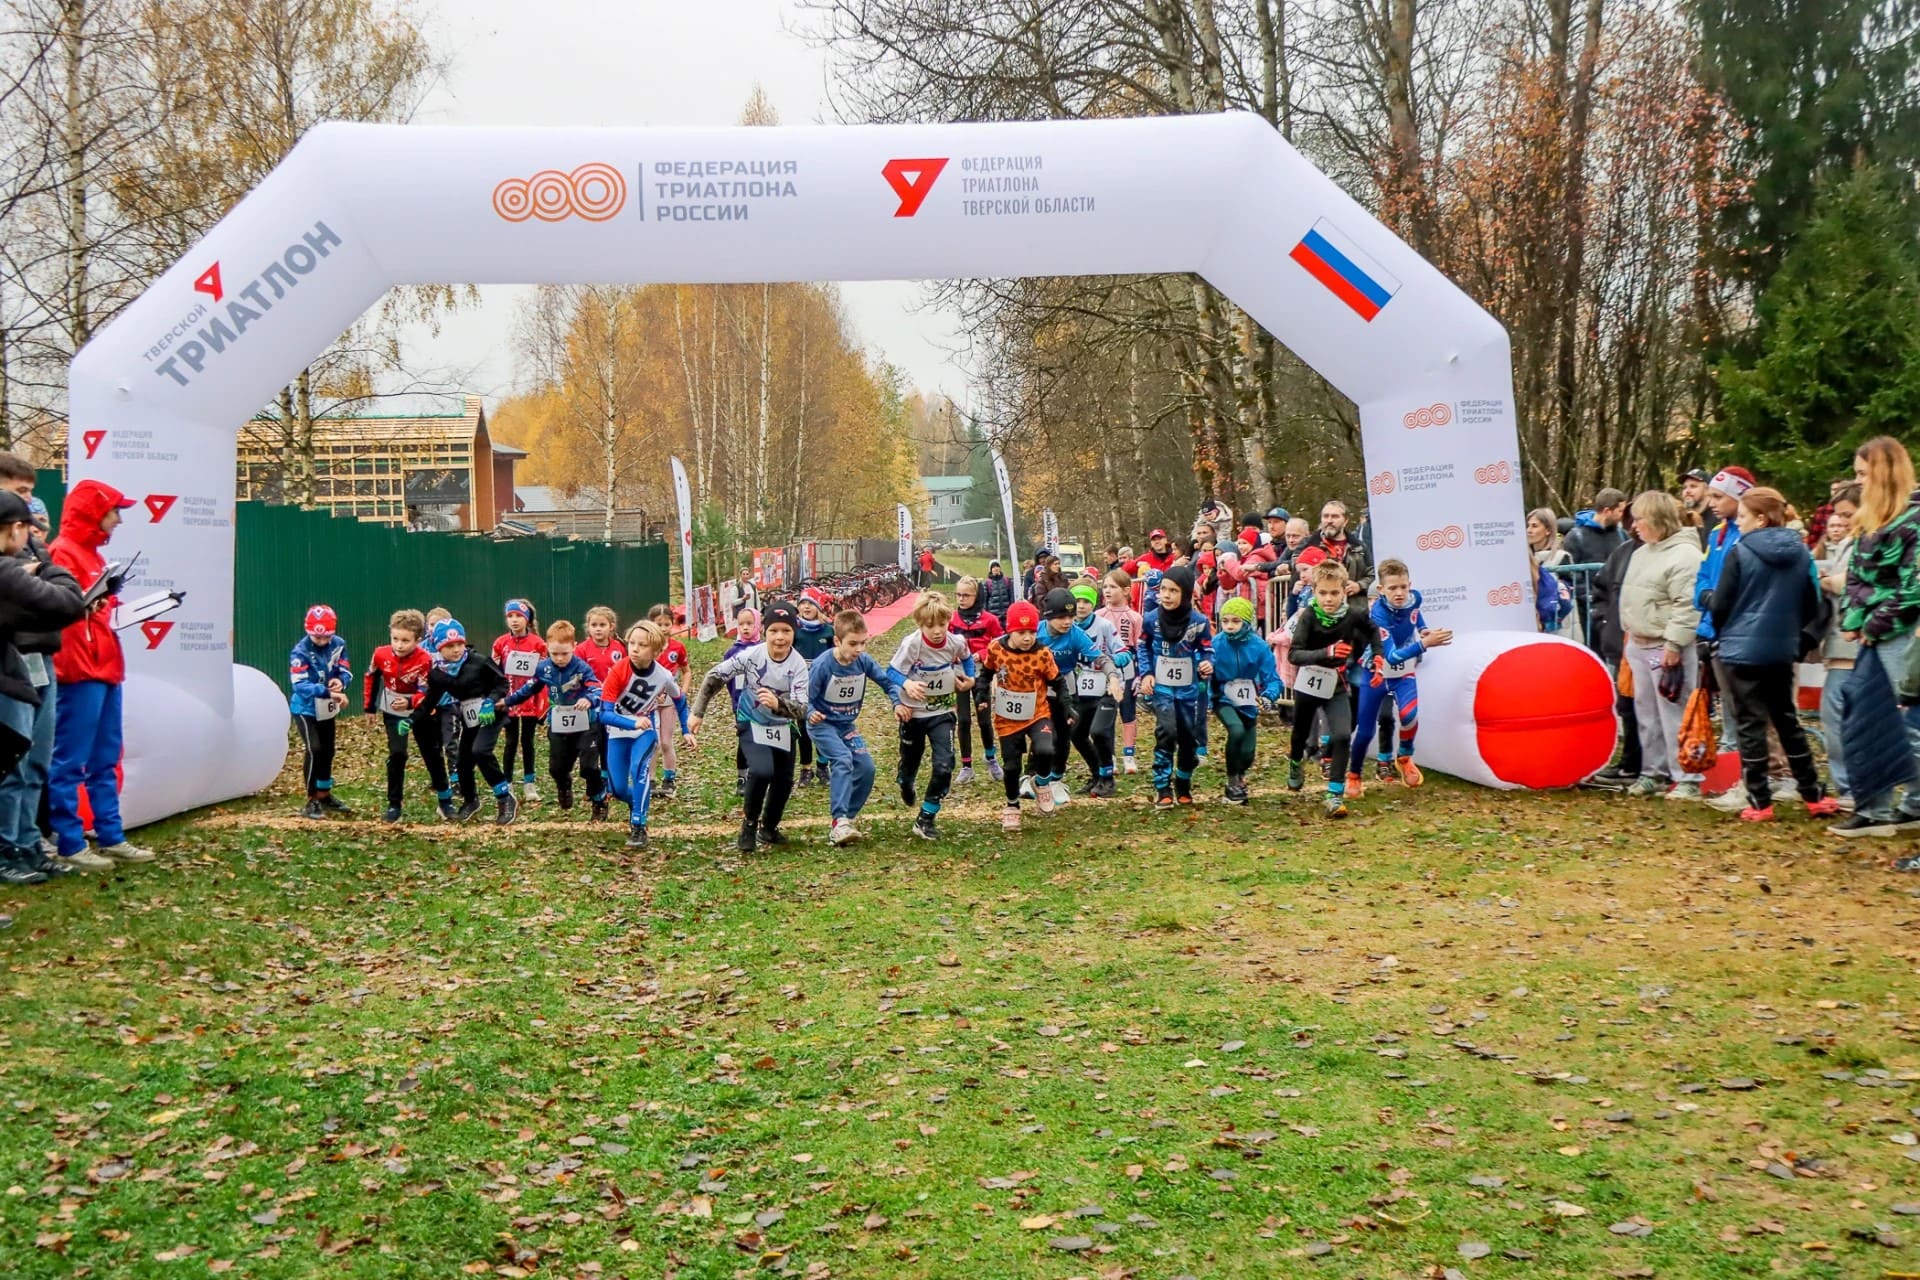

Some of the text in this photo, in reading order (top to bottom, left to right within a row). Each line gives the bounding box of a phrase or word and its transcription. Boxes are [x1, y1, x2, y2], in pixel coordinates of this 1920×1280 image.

[654, 160, 798, 178] ФЕДЕРАЦИЯ
[961, 156, 1043, 174] ФЕДЕРАЦИЯ
[655, 180, 798, 199] ТРИАТЛОНА
[962, 176, 1039, 194] ТРИАТЛОНА
[963, 196, 1095, 216] ТВЕРСКОЙ ОБЛАСТИ
[656, 204, 749, 222] РОССИИ
[154, 220, 343, 387] ТРИАТЛОН
[143, 303, 208, 363] ТВЕРСКОЙ
[1402, 463, 1454, 475] ФЕДЕРАЦИЯ
[1404, 471, 1455, 483] ТРИАТЛОНА
[1404, 482, 1438, 491] РОССИИ
[515, 660, 529, 671] 25
[1166, 668, 1182, 680] 45
[927, 679, 943, 691] 44
[1081, 679, 1095, 690] 53
[1307, 676, 1323, 690] 41
[839, 687, 855, 698] 59
[1237, 688, 1250, 700] 47
[1006, 701, 1022, 714] 38
[466, 709, 477, 721] 40
[562, 715, 576, 727] 57
[766, 728, 781, 741] 54
